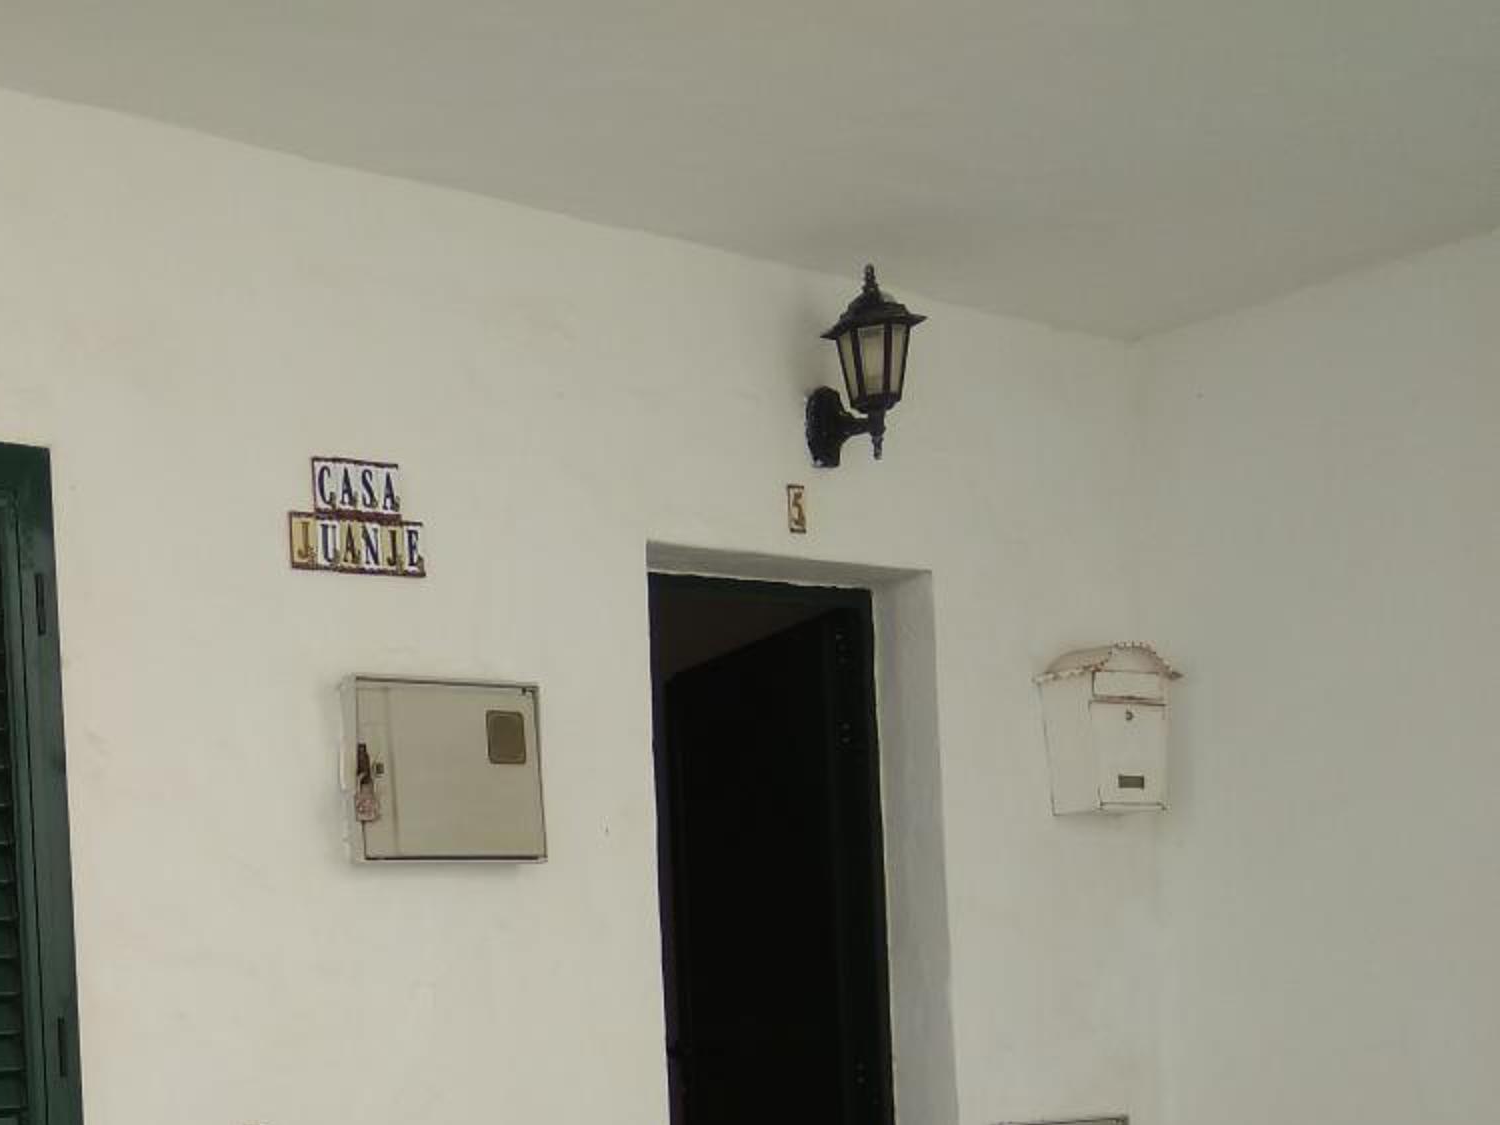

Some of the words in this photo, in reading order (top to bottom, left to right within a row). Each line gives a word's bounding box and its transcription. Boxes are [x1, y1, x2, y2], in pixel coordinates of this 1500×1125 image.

[318, 465, 399, 511] CASA
[791, 492, 805, 526] 5
[296, 521, 423, 567] JUANJE
